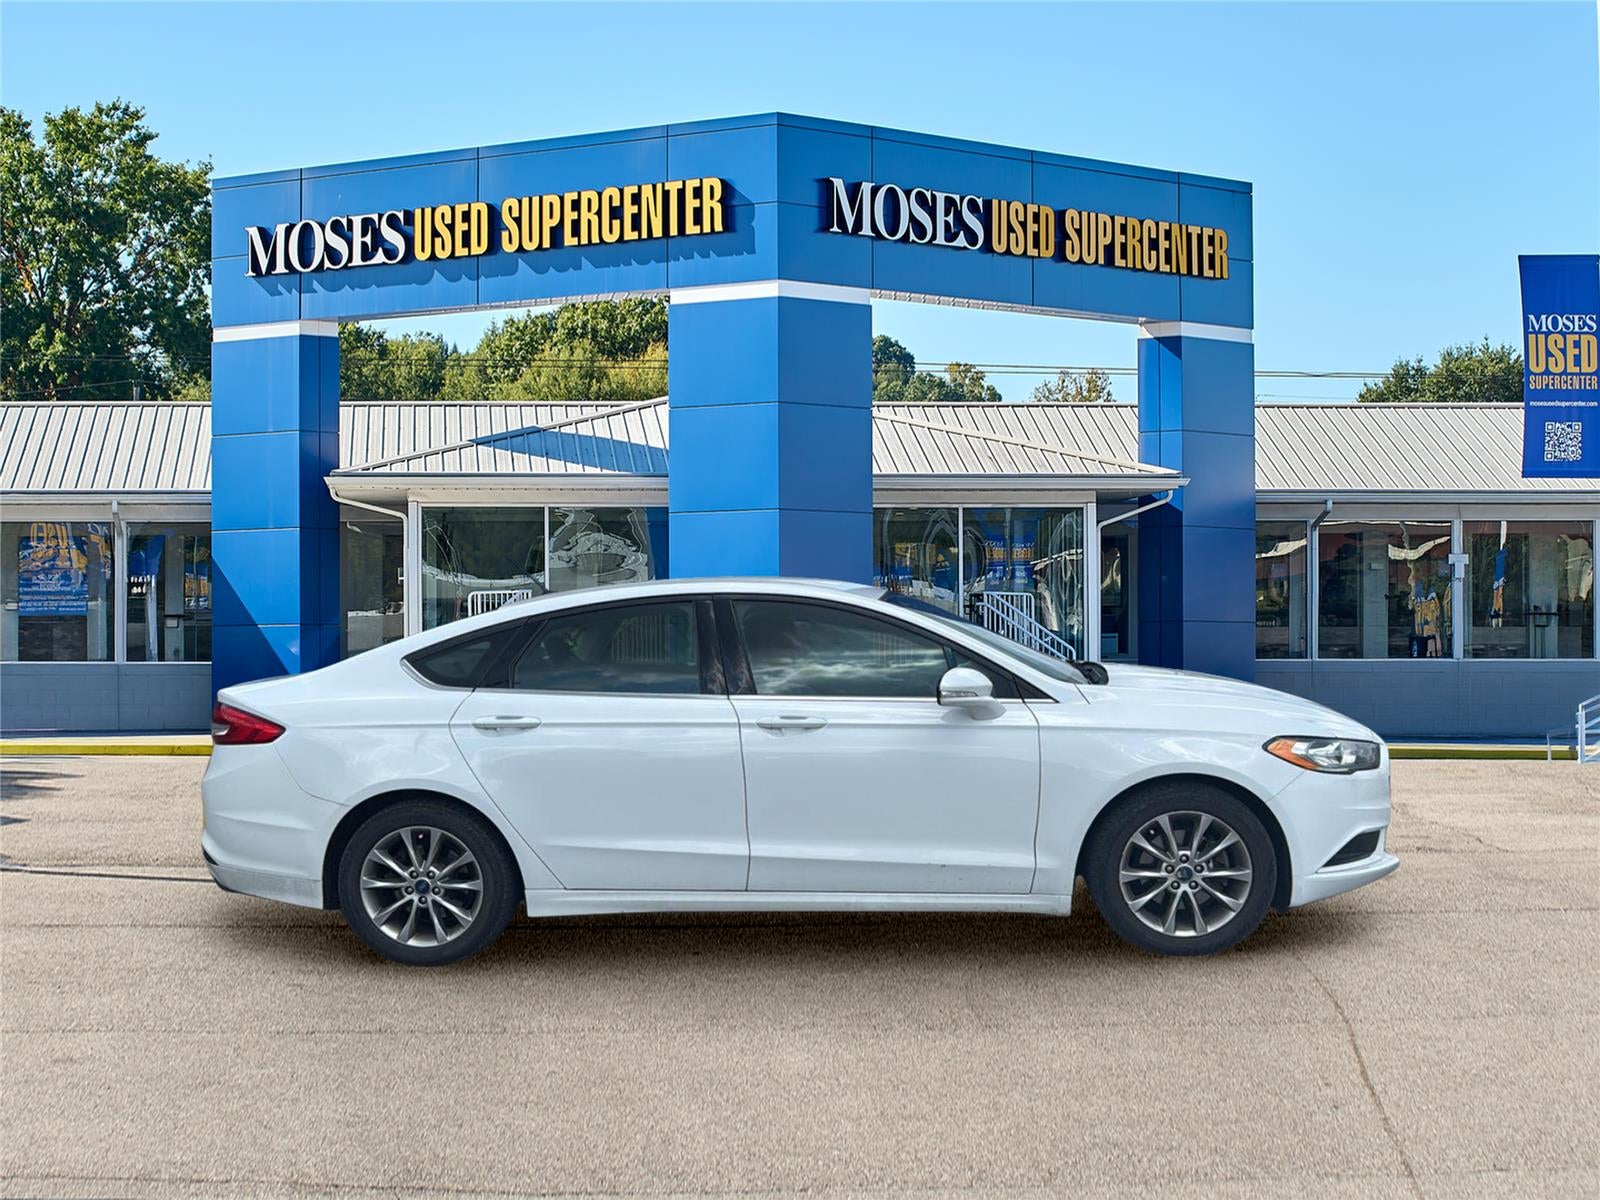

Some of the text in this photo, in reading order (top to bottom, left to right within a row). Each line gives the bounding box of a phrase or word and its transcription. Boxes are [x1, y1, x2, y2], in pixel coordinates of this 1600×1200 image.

[244, 176, 723, 277] MOSES USED SUPERCENTER
[828, 177, 1229, 280] MOSES USED SUPERCENTER
[1528, 313, 1598, 333] MOSES
[1528, 333, 1598, 374] USED
[1529, 375, 1598, 390] SUPERCENTER
[1529, 400, 1598, 408] mosesusedsupercenter.com
